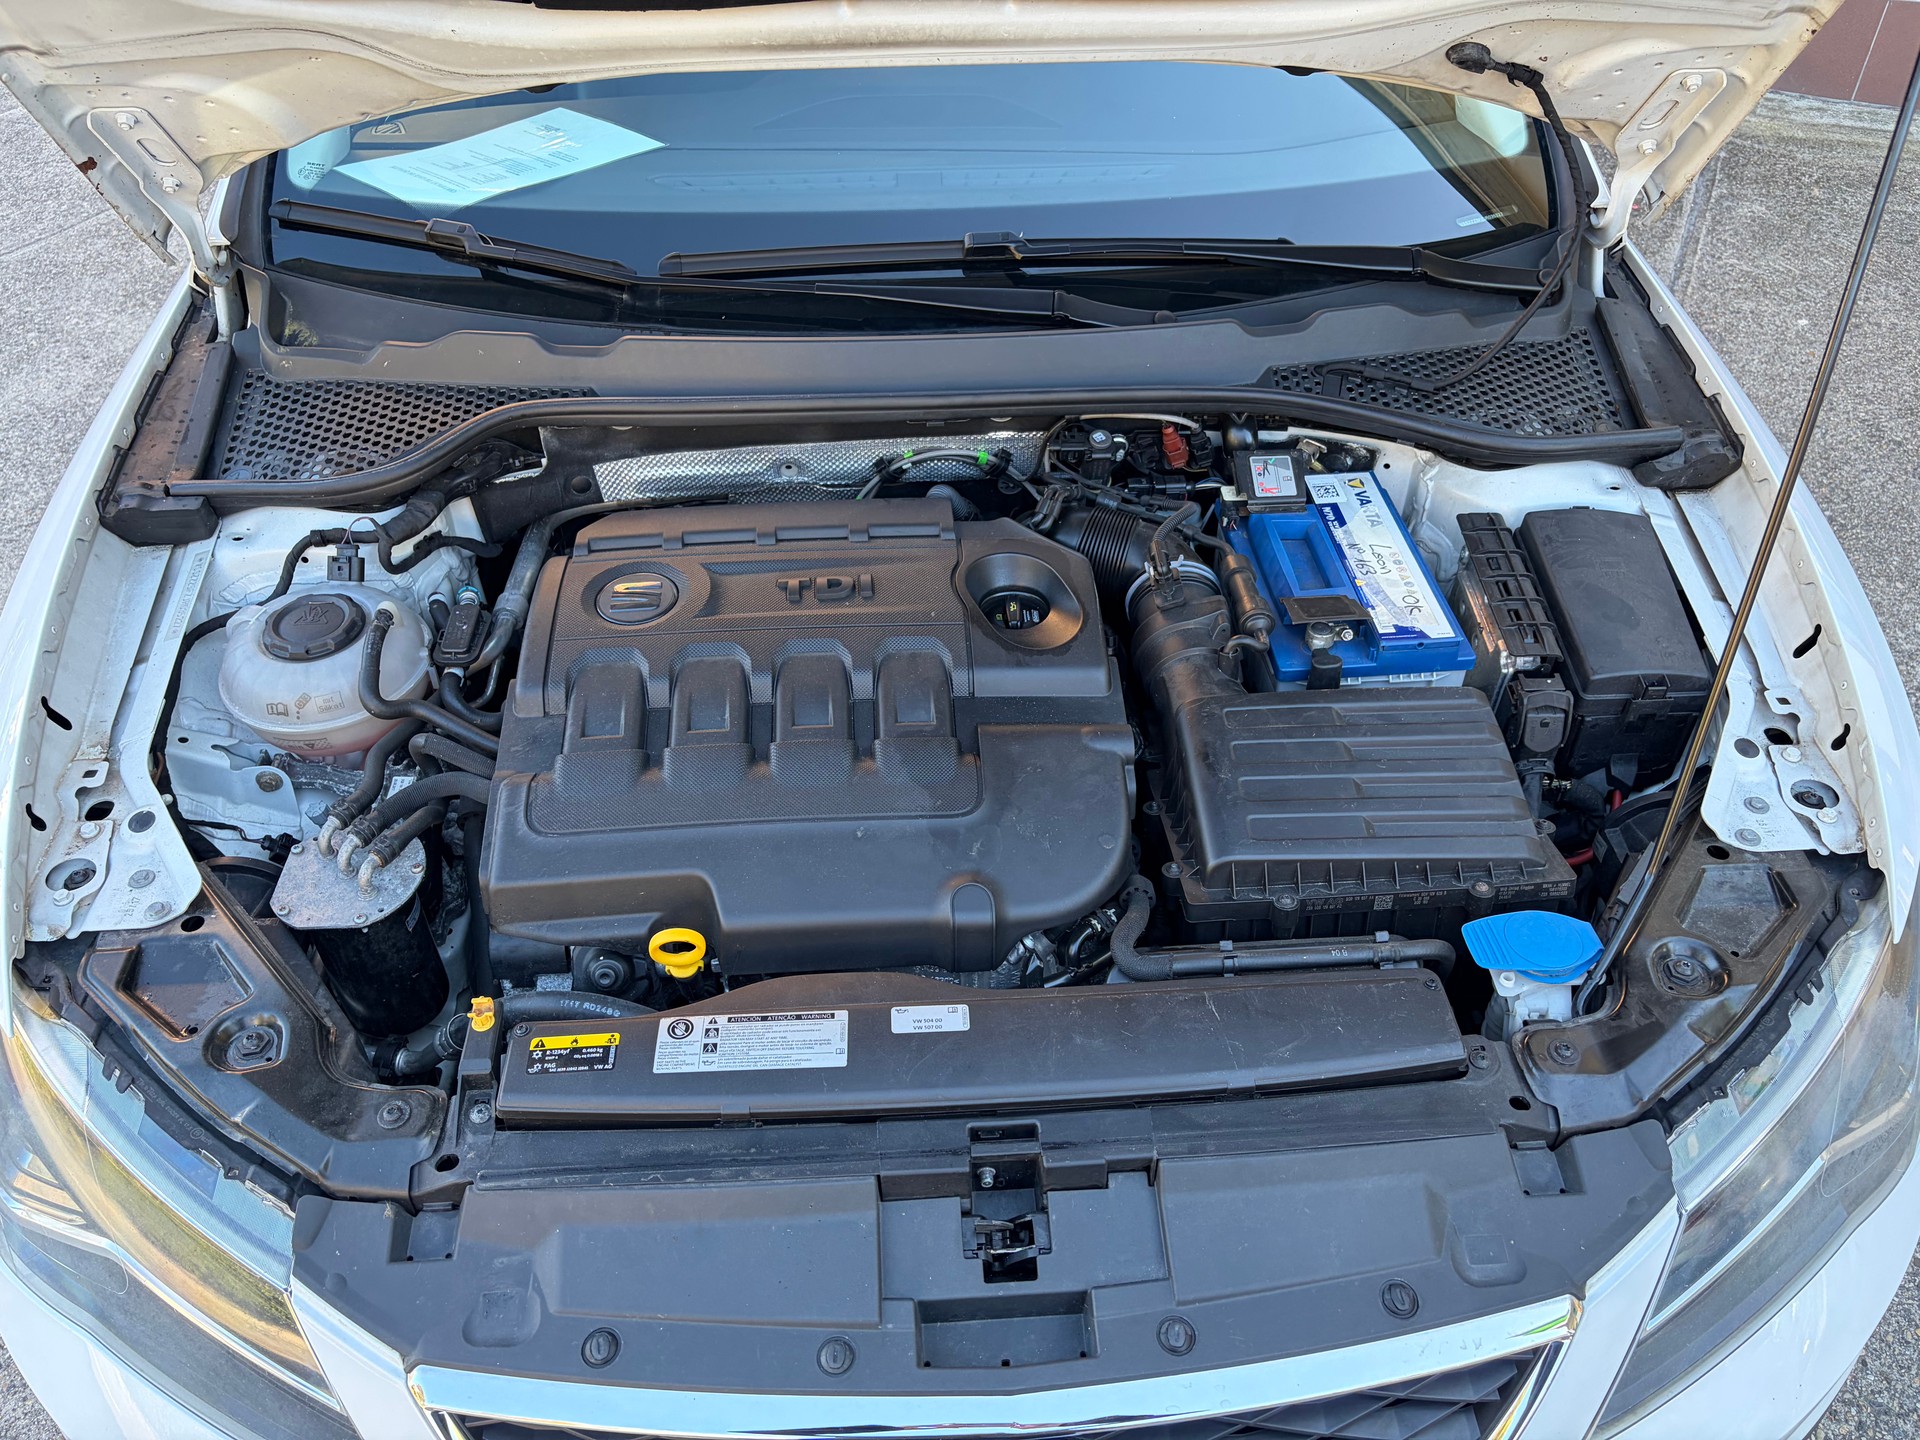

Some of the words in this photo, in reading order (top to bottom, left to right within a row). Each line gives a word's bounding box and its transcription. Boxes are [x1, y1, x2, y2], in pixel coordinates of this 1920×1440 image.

[1321, 506, 1335, 521] N70
[1354, 556, 1378, 578] 163
[776, 572, 876, 602] TDI
[319, 702, 343, 713] Silikat
